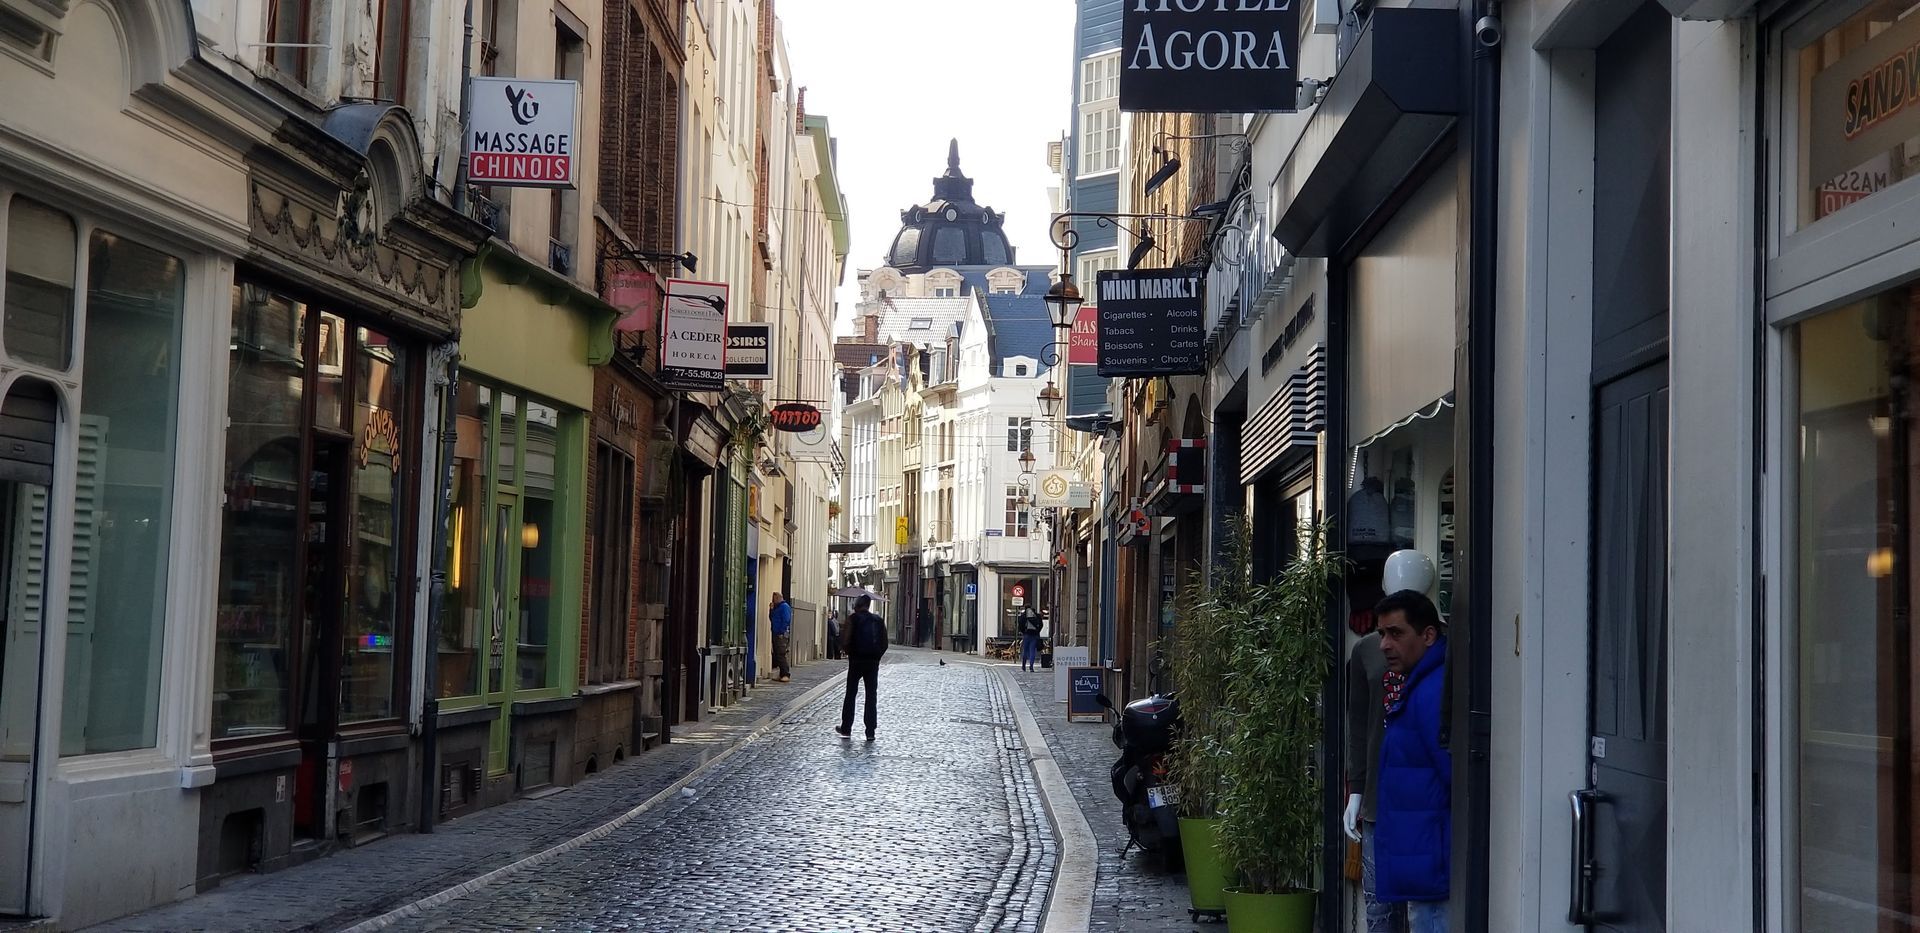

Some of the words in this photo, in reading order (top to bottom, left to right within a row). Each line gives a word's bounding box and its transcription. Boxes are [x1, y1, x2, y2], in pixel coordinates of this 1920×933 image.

[1128, 23, 1289, 70] AGORA
[474, 131, 568, 154] MASSAGE
[473, 155, 566, 179] CHINOIS
[1103, 280, 1136, 301] MINI
[1103, 310, 1146, 321] Cigarettes
[1167, 308, 1197, 318] Alcools
[1104, 326, 1135, 335] Tabacs
[1171, 324, 1198, 334] Drinks
[670, 331, 678, 340] A
[681, 331, 721, 343] CEDER
[1104, 341, 1143, 350] Boissons
[1170, 339, 1198, 348] Cartes
[672, 351, 717, 361] HORECA
[1105, 355, 1147, 365] Souvenirs
[665, 368, 723, 380] 77-55.98.28
[772, 410, 820, 425] TATTOO
